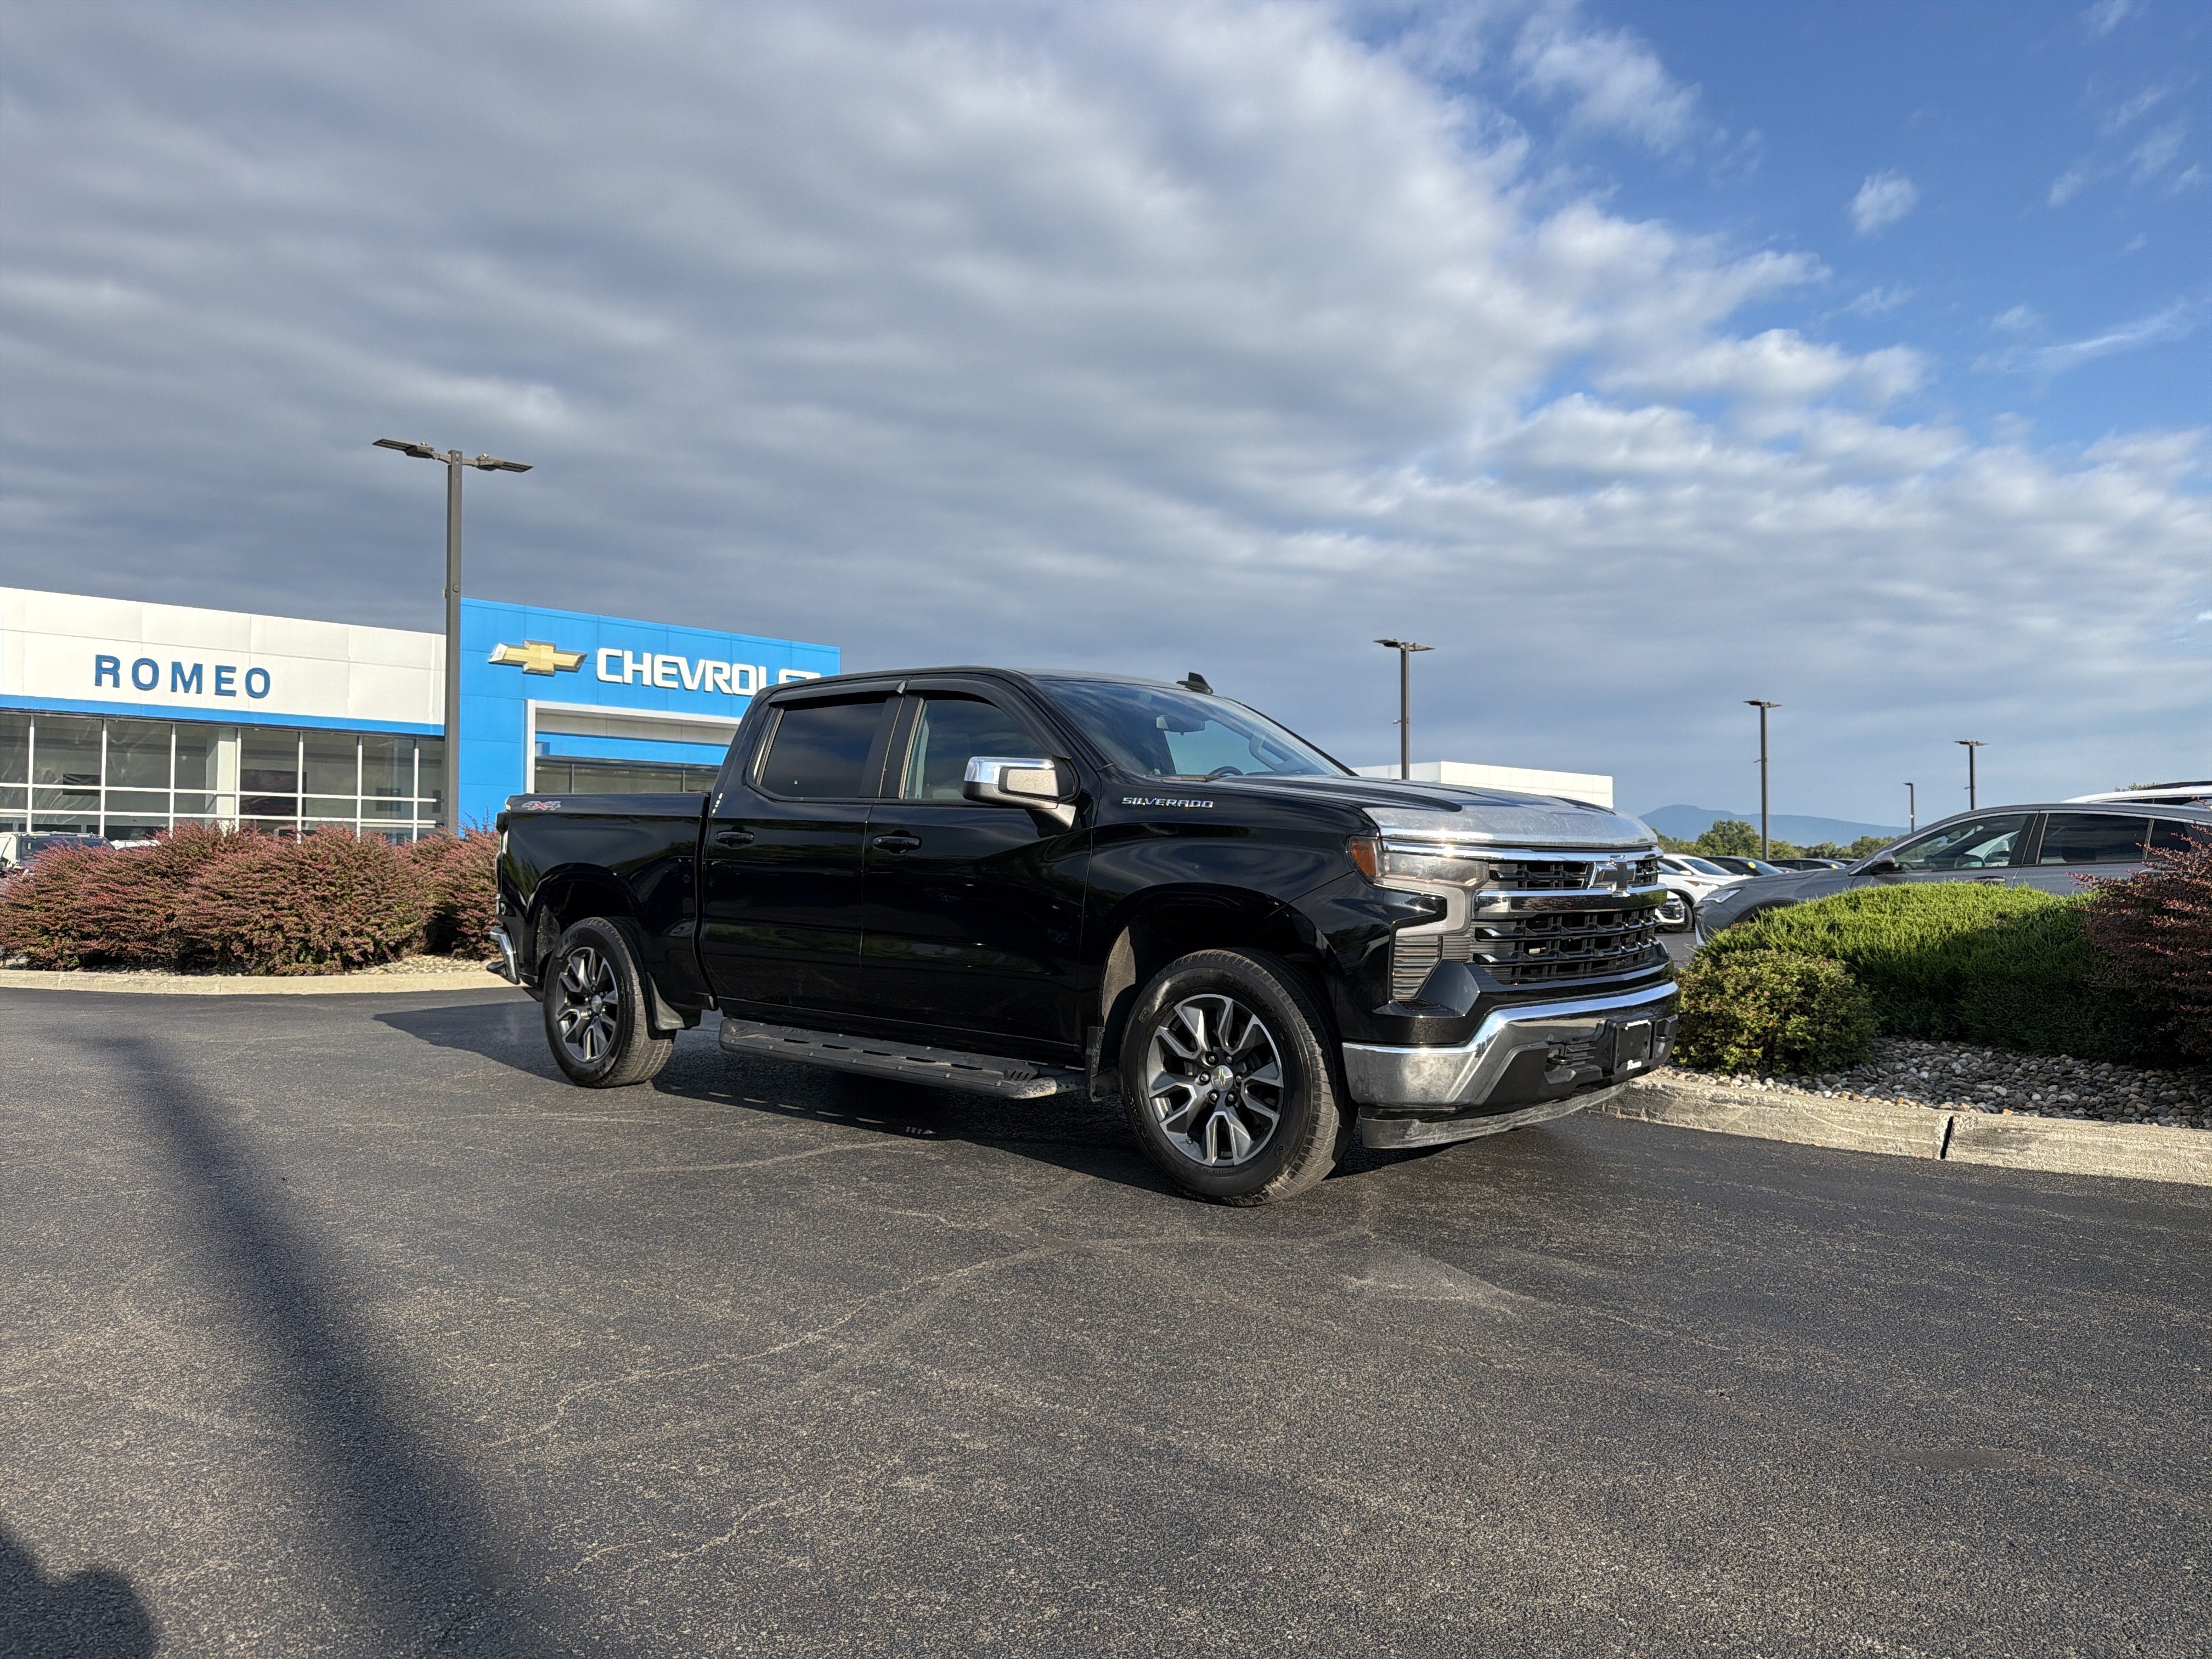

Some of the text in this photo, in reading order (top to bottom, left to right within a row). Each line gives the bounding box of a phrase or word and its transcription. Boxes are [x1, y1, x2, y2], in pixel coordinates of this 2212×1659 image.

[94, 654, 270, 699] ROMEO
[597, 647, 821, 696] CHEVROL
[1121, 797, 1214, 808] SILVERADO
